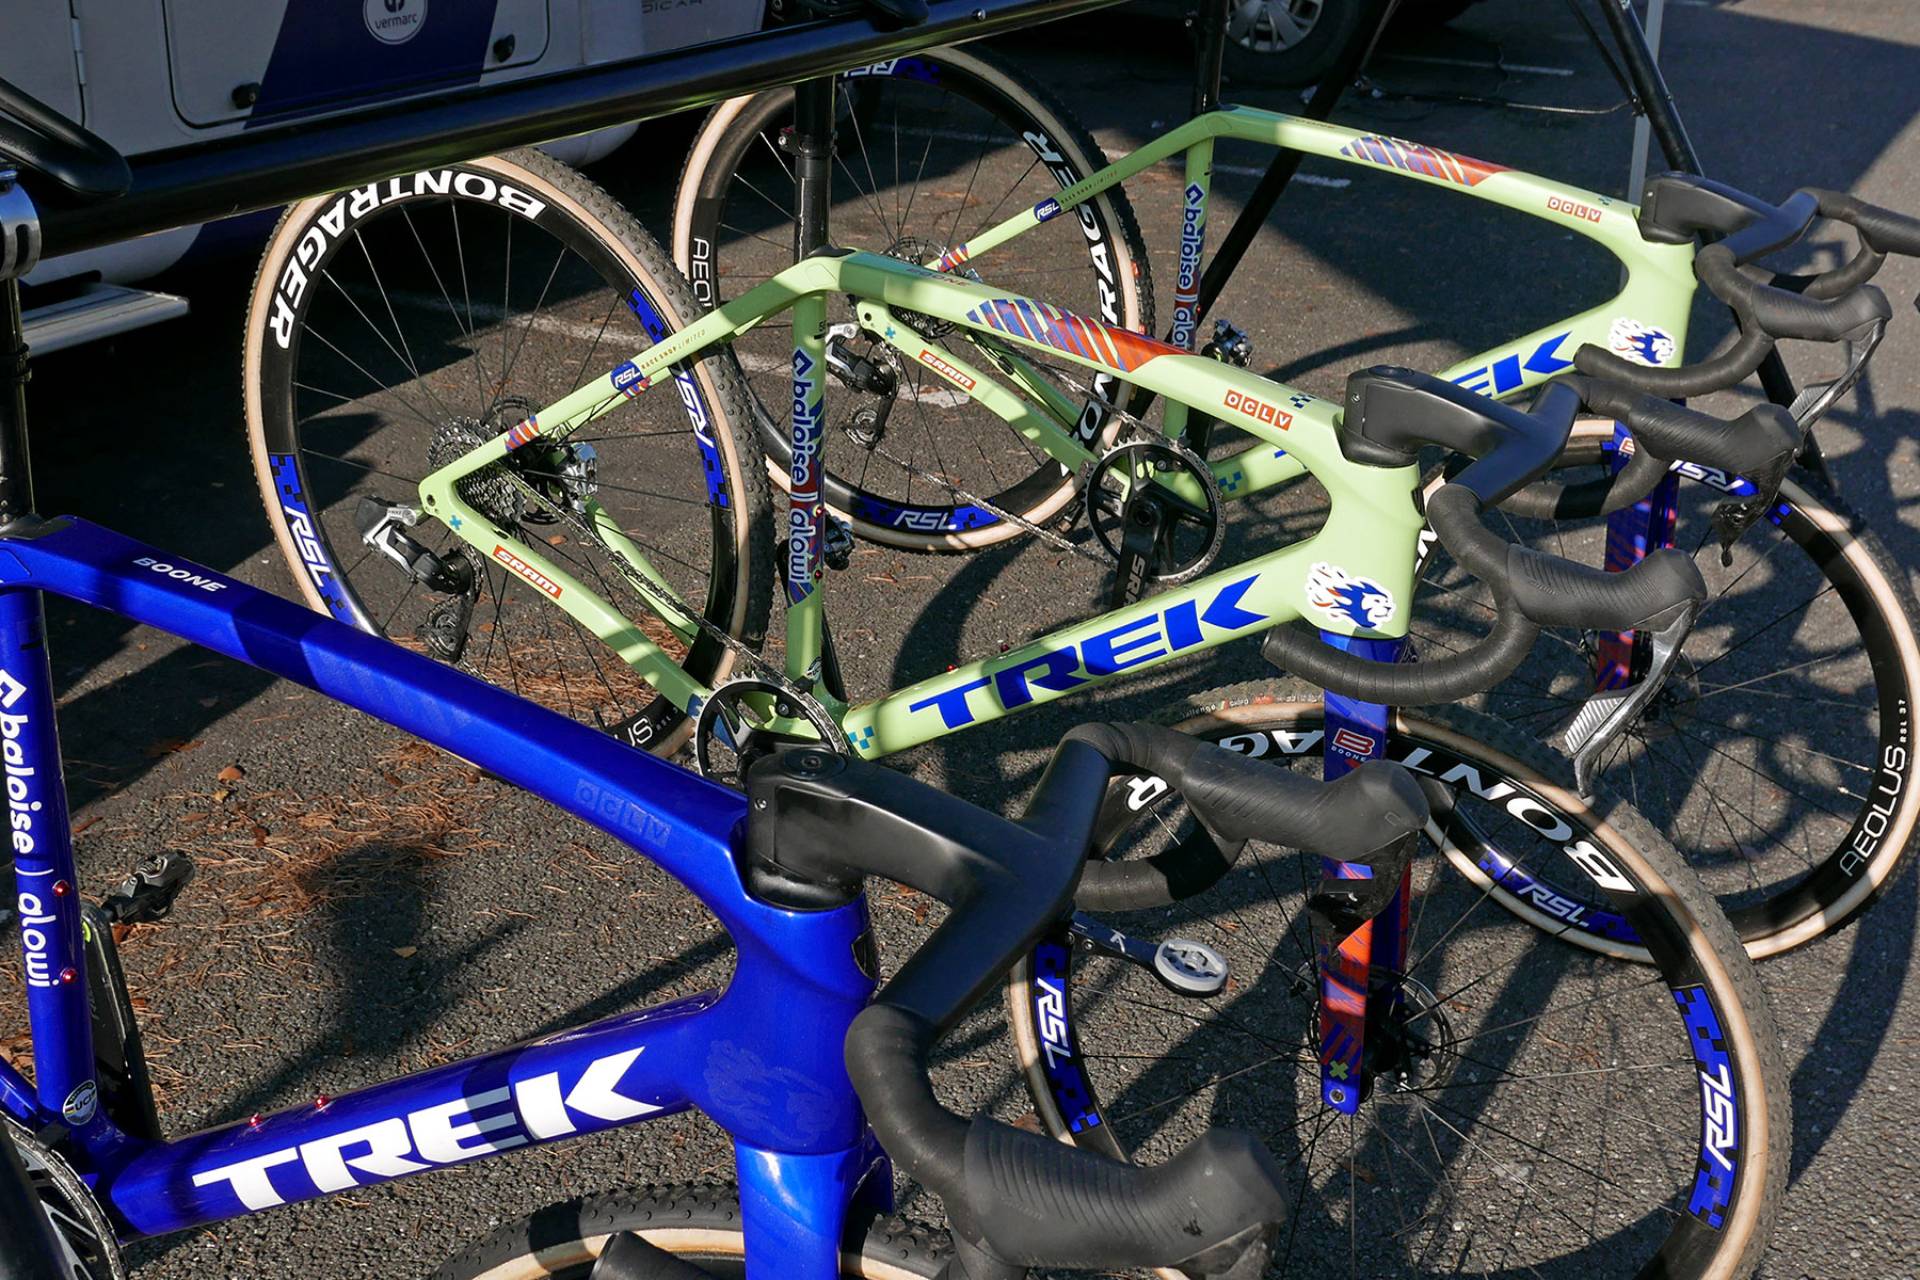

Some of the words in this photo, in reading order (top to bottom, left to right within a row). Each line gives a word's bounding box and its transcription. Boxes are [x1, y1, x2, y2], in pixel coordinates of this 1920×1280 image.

[375, 14, 417, 29] vermarc
[1036, 202, 1060, 219] RSL
[1547, 198, 1600, 222] OCLV
[270, 170, 547, 349] BONTRAGER
[1178, 207, 1201, 289] baloise
[615, 367, 641, 388] RSL
[921, 353, 974, 388] SRAM
[792, 380, 816, 484] baloise
[1224, 390, 1292, 430] OCLV
[284, 505, 331, 587] RSL
[893, 510, 957, 530] RSL
[132, 557, 227, 592] BOONE
[495, 548, 560, 596] SRAM
[909, 573, 1270, 729] TREK
[1331, 745, 1367, 762] BOONE
[1, 712, 42, 854] baloise
[577, 782, 670, 845] OCLV
[1839, 745, 1906, 877] AEOLUS
[1517, 883, 1589, 927] RSL
[1037, 976, 1071, 1069] RSL
[192, 1046, 664, 1211] TREK
[1700, 1063, 1734, 1171] RSL
